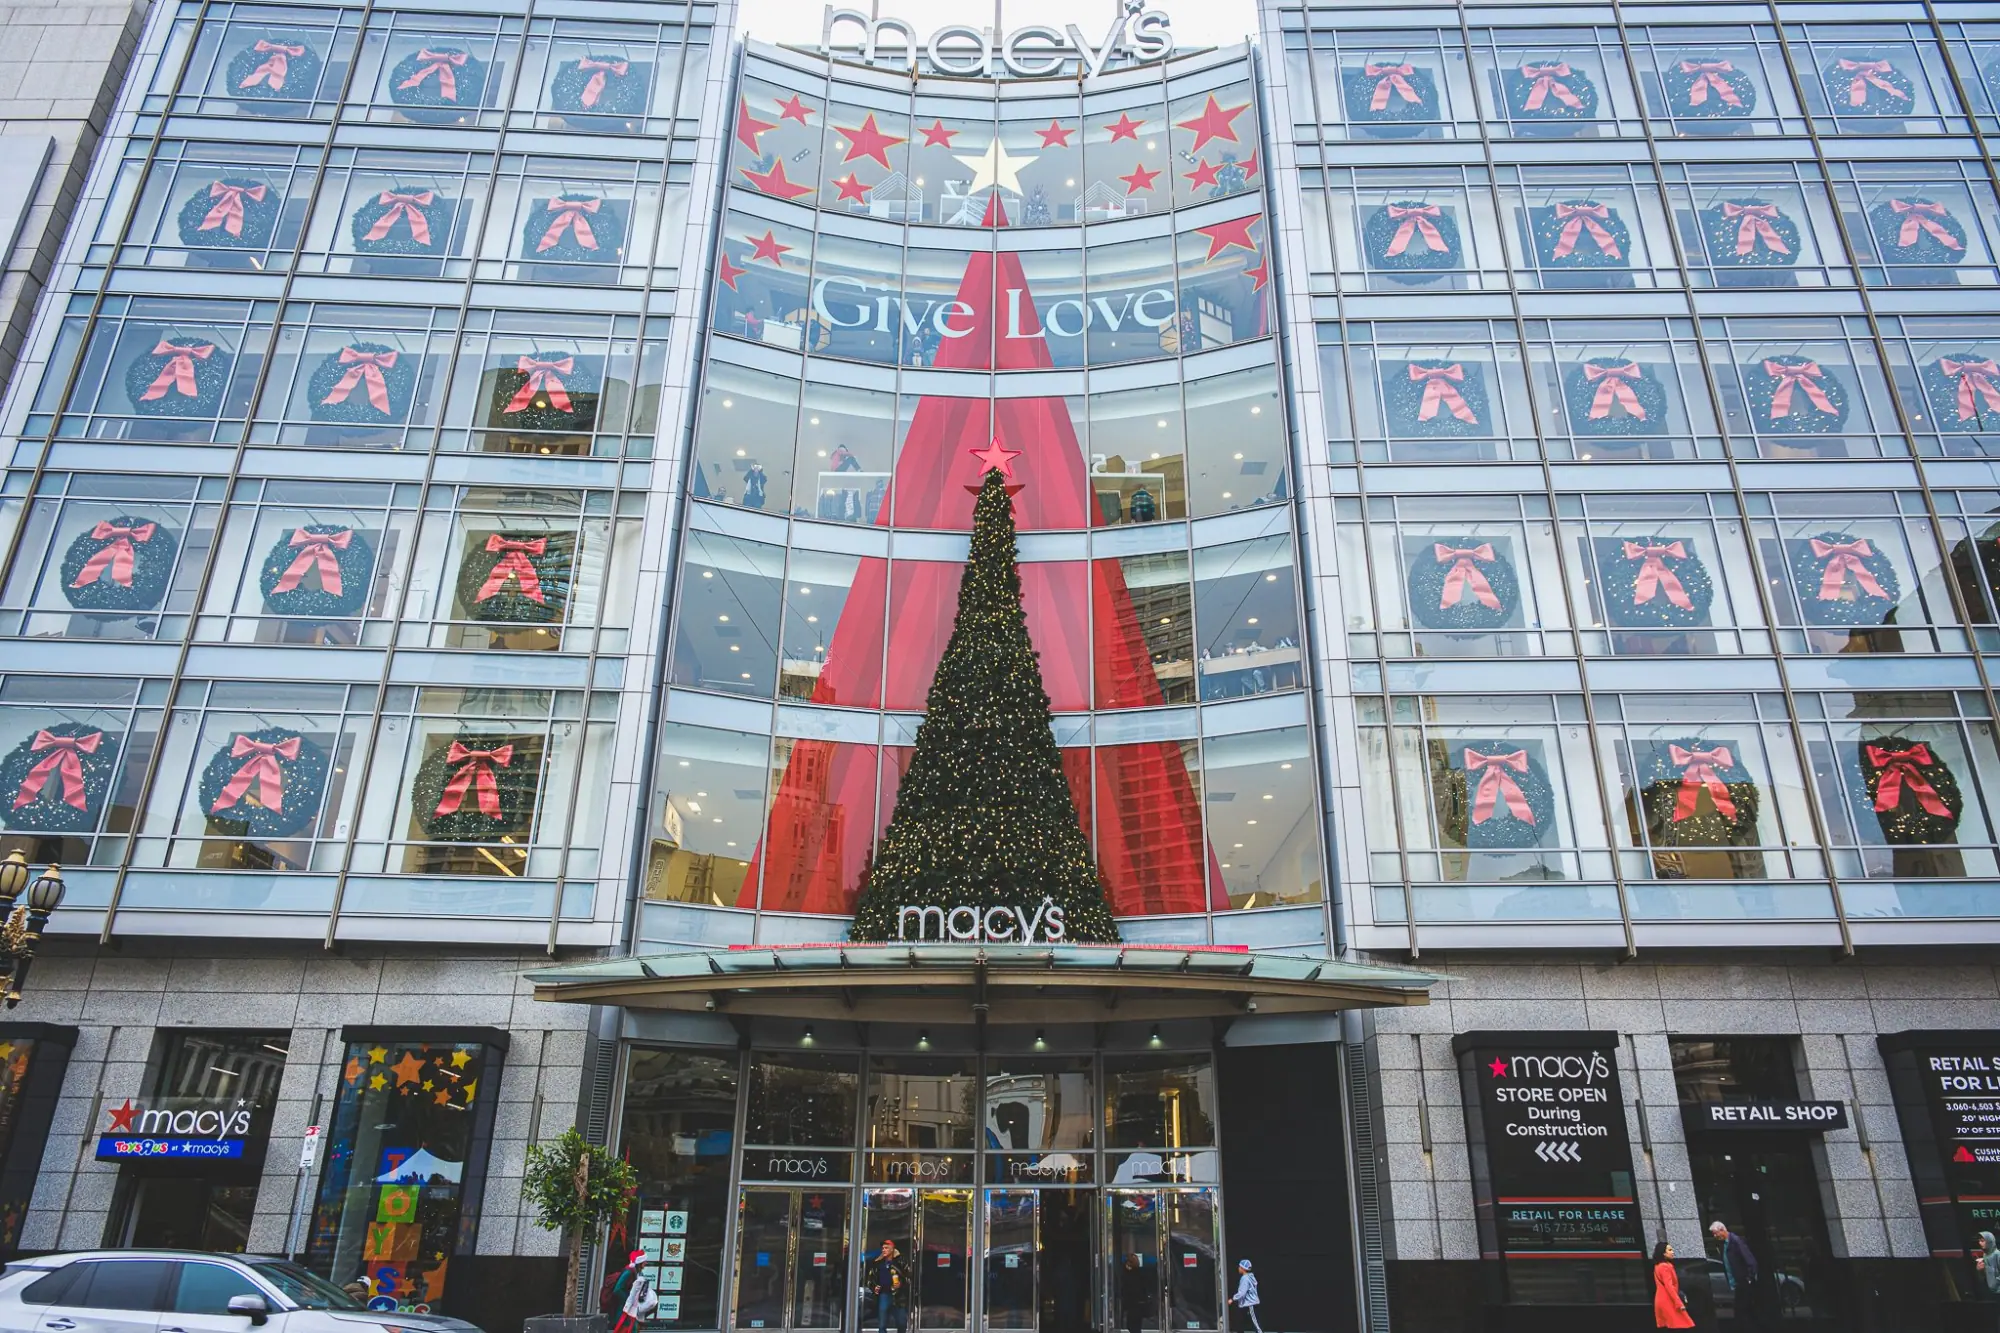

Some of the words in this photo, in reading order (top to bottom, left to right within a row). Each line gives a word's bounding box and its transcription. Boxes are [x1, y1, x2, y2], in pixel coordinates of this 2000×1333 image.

[820, 0, 1174, 78] macy's
[813, 275, 975, 338] Give
[1005, 288, 1176, 339] Love
[898, 894, 1066, 946] macy's
[1511, 1050, 1609, 1085] macy's
[1929, 1057, 1990, 1070] RETAIL
[1940, 1076, 1982, 1090] FOR
[1496, 1088, 1554, 1102] STORE
[1559, 1088, 1607, 1102] OPEN
[139, 1097, 251, 1142] macy's
[1528, 1107, 1581, 1122] During
[1711, 1106, 1781, 1120] RETAIL
[1785, 1106, 1838, 1120] SHOP
[1506, 1123, 1608, 1136] Construction
[769, 1157, 827, 1178] macy's
[890, 1159, 948, 1180] macy's
[1512, 1210, 1554, 1220] RETAIL
[1558, 1210, 1583, 1220] FOR
[1587, 1210, 1625, 1220] LEASE
[1533, 1223, 1551, 1233] 415
[1555, 1223, 1576, 1233] 773
